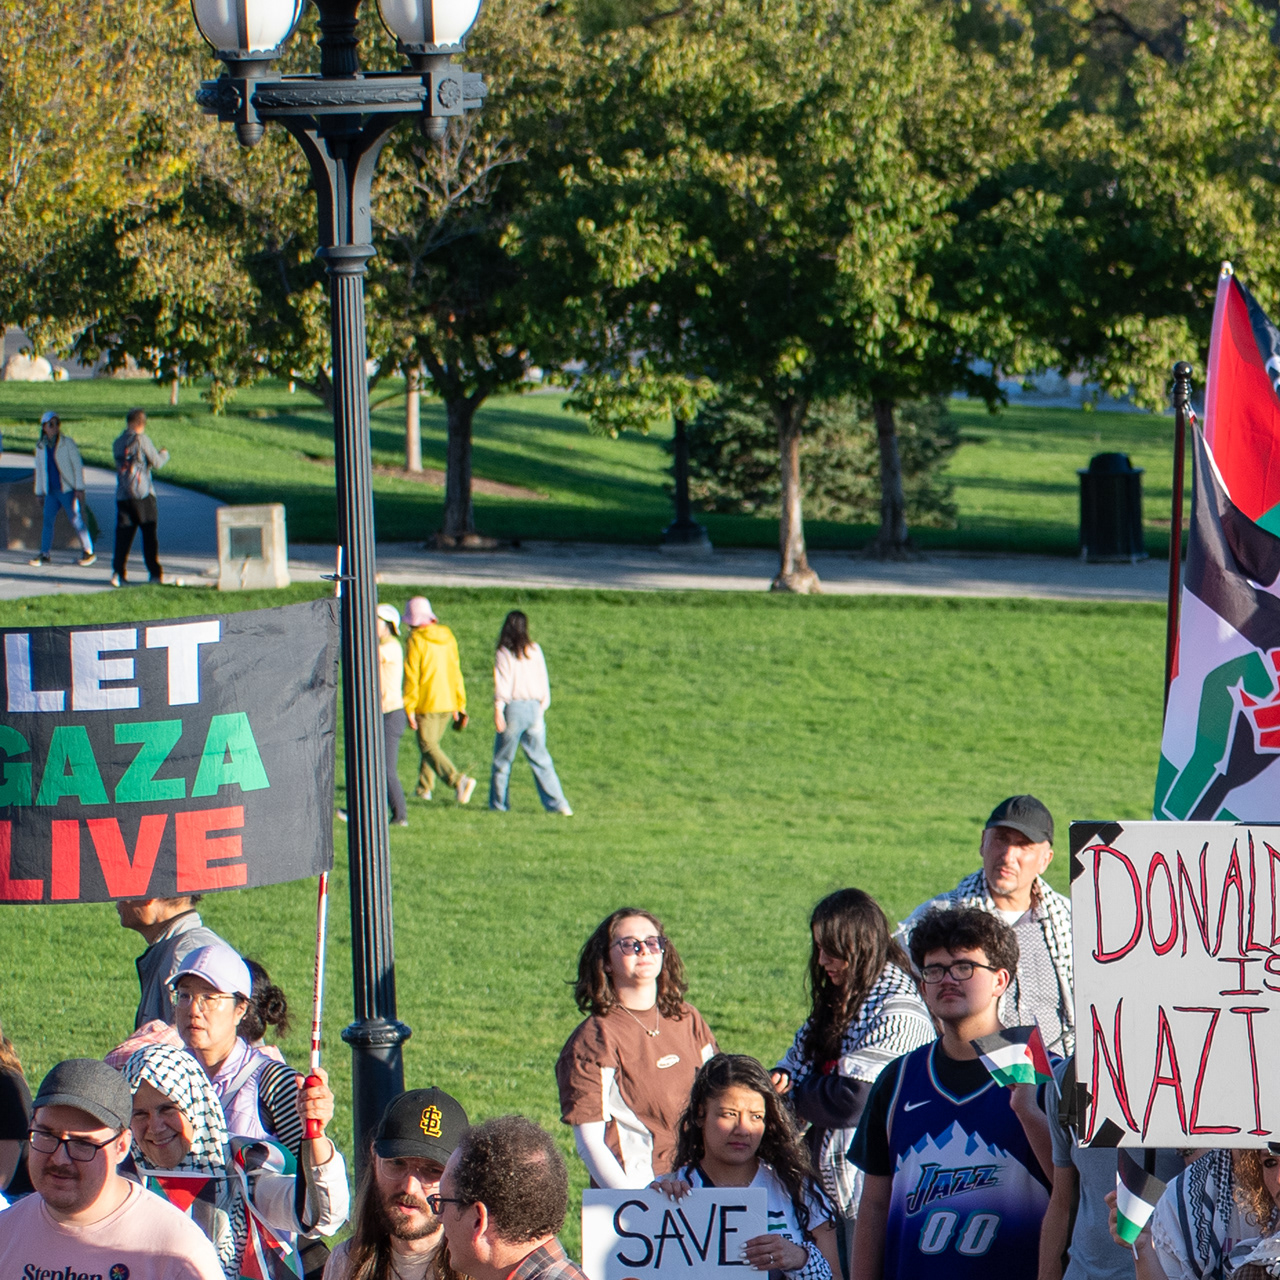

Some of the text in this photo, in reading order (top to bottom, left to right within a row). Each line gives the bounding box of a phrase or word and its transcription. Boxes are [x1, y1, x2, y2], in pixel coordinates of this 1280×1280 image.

[4, 620, 220, 712] LET
[0, 805, 248, 900] LIVE
[1082, 997, 1273, 1145] NAZI
[613, 1199, 751, 1269] SAVE
[918, 1208, 1002, 1257] 00
